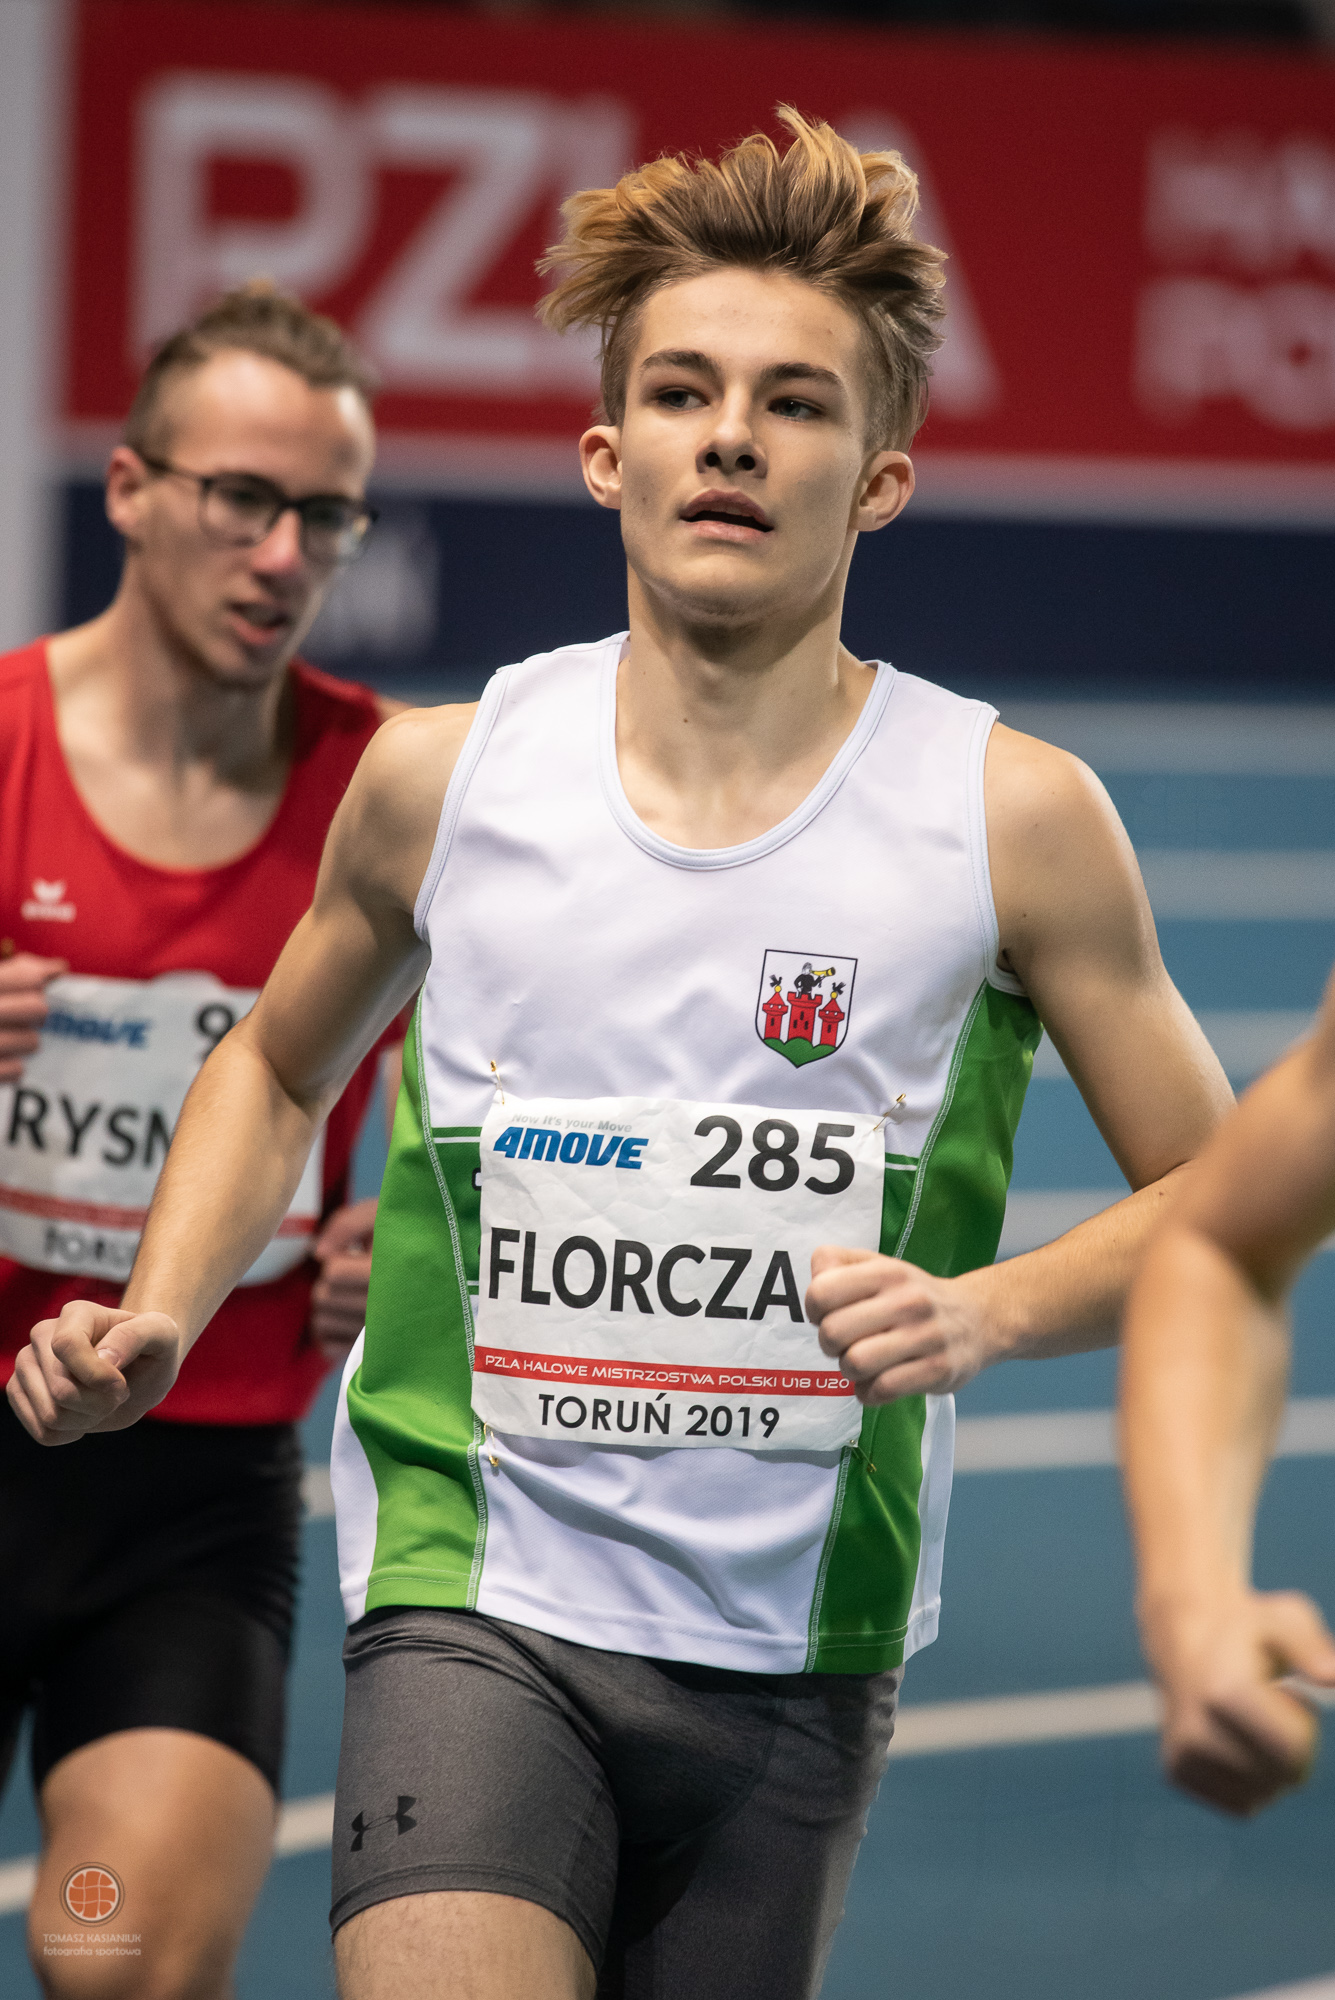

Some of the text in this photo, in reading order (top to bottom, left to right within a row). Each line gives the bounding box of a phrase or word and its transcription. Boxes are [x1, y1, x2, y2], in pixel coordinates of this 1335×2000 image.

[511, 1113, 632, 1133] Now It's your Move
[493, 1126, 649, 1170] 4MOVE
[690, 1115, 855, 1195] 285
[488, 1226, 812, 1325] FLORCZA
[485, 1354, 850, 1389] PZLA HALOWE MISTRZOSTWA POLSKI U18 U20
[538, 1392, 780, 1439] TORUŃ 2019
